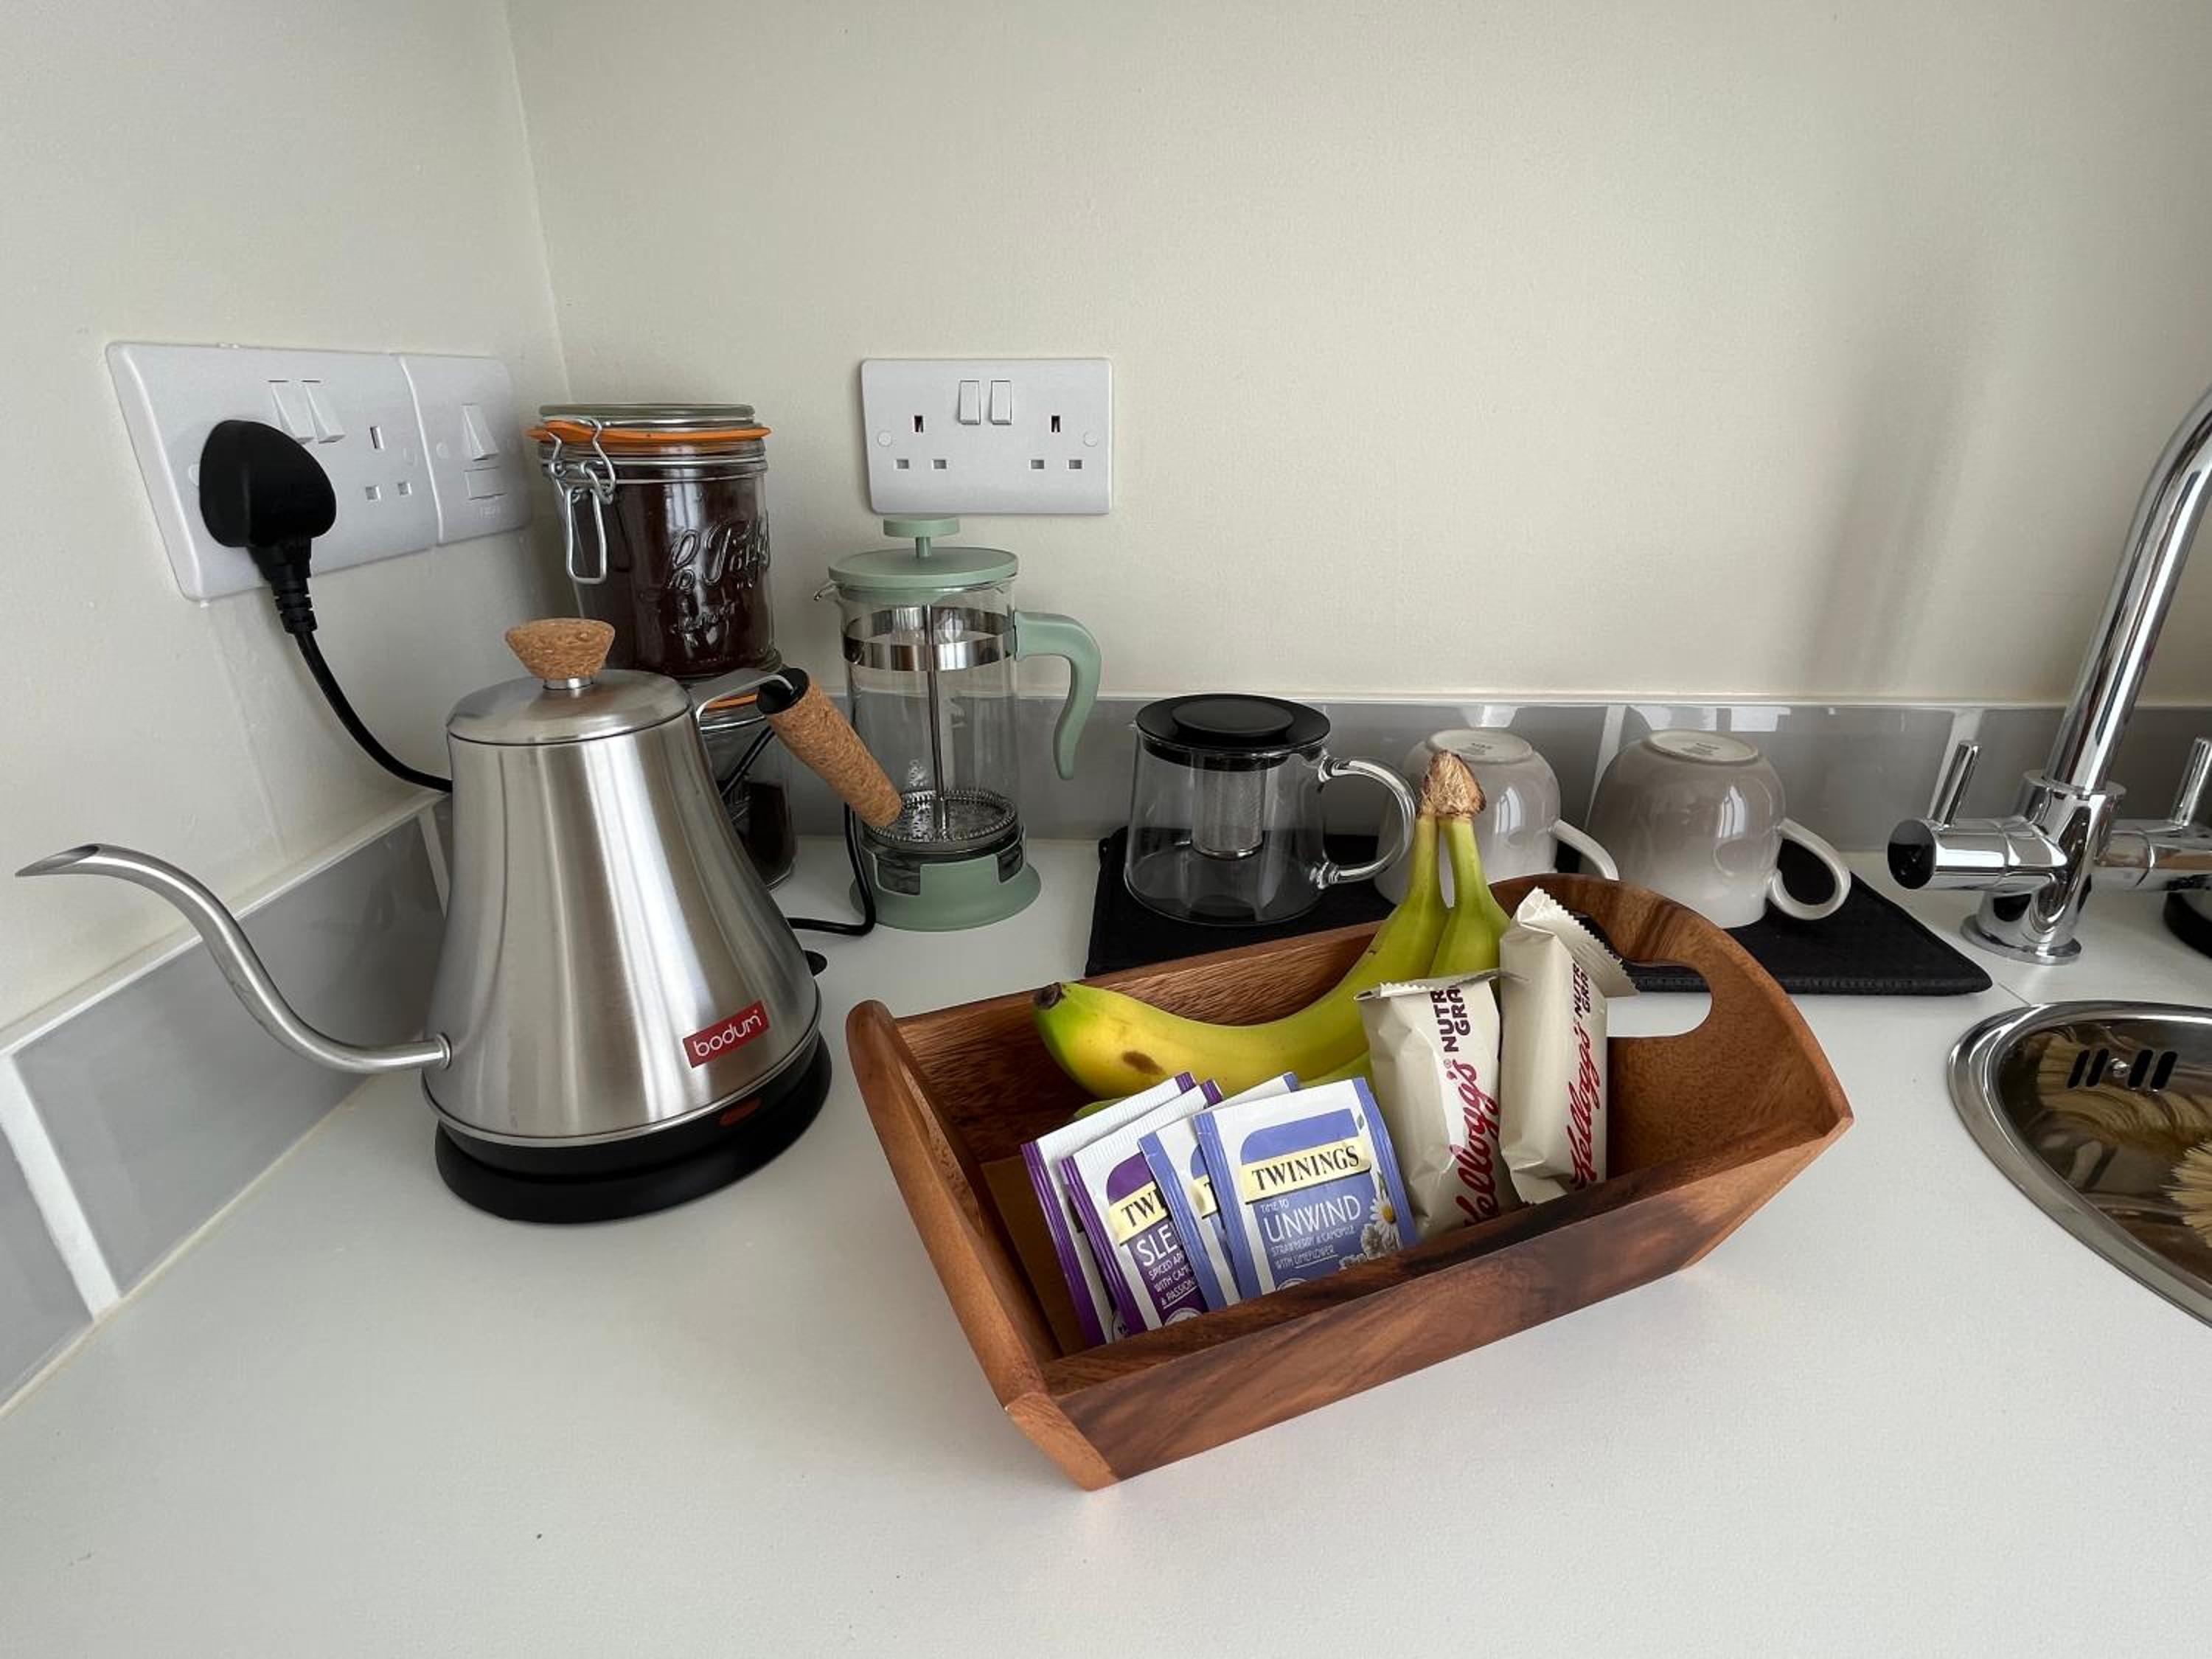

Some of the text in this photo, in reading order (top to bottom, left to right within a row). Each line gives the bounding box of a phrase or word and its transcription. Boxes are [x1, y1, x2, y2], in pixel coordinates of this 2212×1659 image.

[692, 1013, 762, 1057] bodum
[1430, 990, 1459, 1052] NUTR
[1251, 1145, 1360, 1192] TWININGS
[1263, 1195, 1361, 1242] UNWIND
[1136, 1224, 1178, 1267] SLE
[1148, 1259, 1173, 1281] SPICED
[1154, 1275, 1172, 1293] WITH
